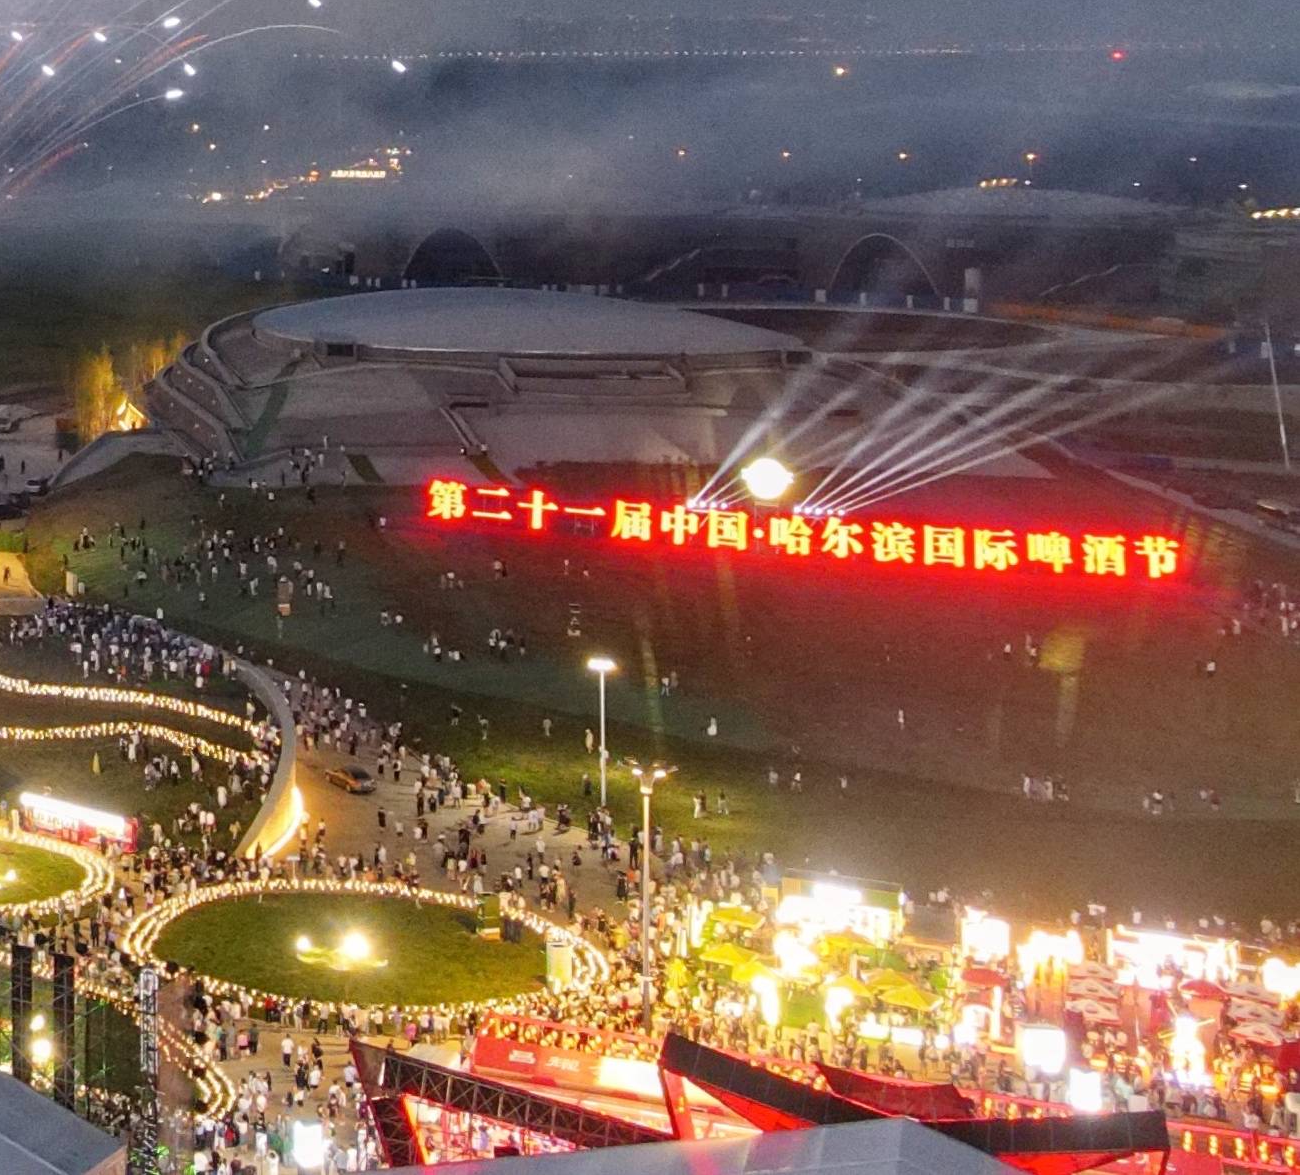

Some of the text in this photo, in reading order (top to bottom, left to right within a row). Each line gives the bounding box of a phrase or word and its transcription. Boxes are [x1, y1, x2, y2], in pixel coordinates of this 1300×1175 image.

[426, 479, 1181, 579] 第二十一届中国·哈尔滨国际啤酒节
